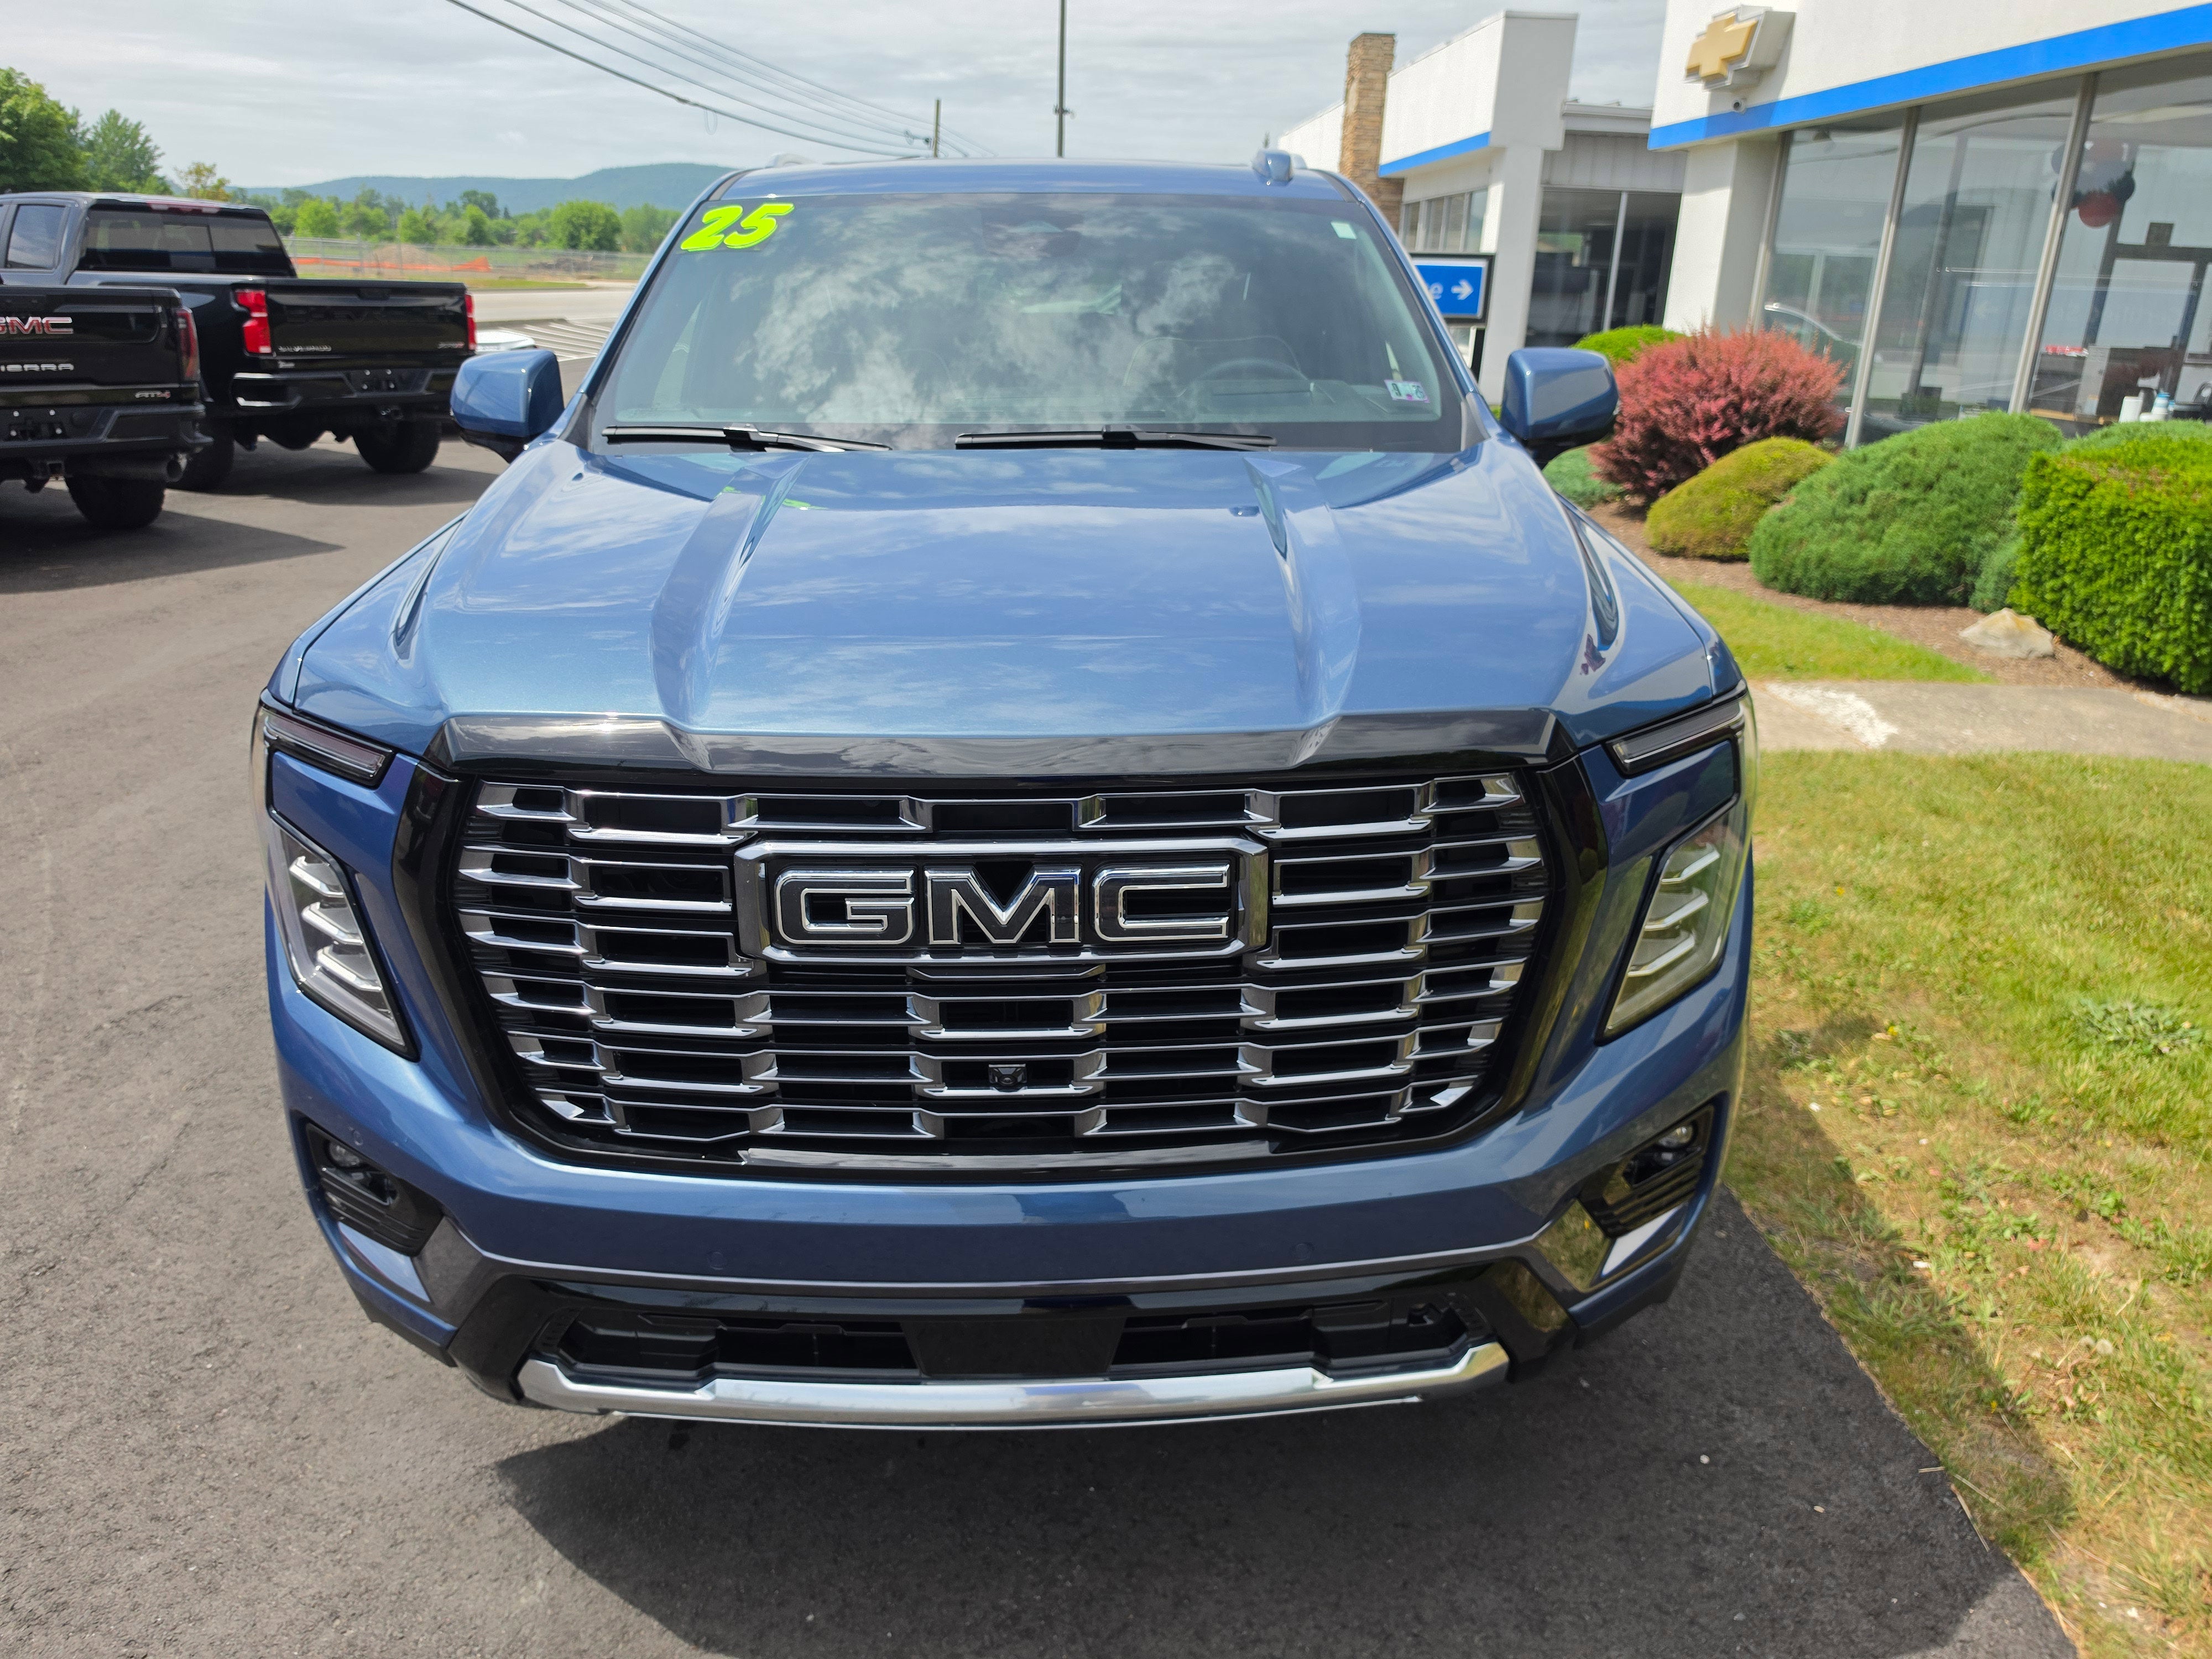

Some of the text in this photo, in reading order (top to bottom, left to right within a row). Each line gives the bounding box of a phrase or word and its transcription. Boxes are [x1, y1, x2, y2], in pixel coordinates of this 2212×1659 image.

[680, 203, 795, 252] 25
[0, 363, 75, 372] IERRA
[775, 864, 1230, 945] GMC
